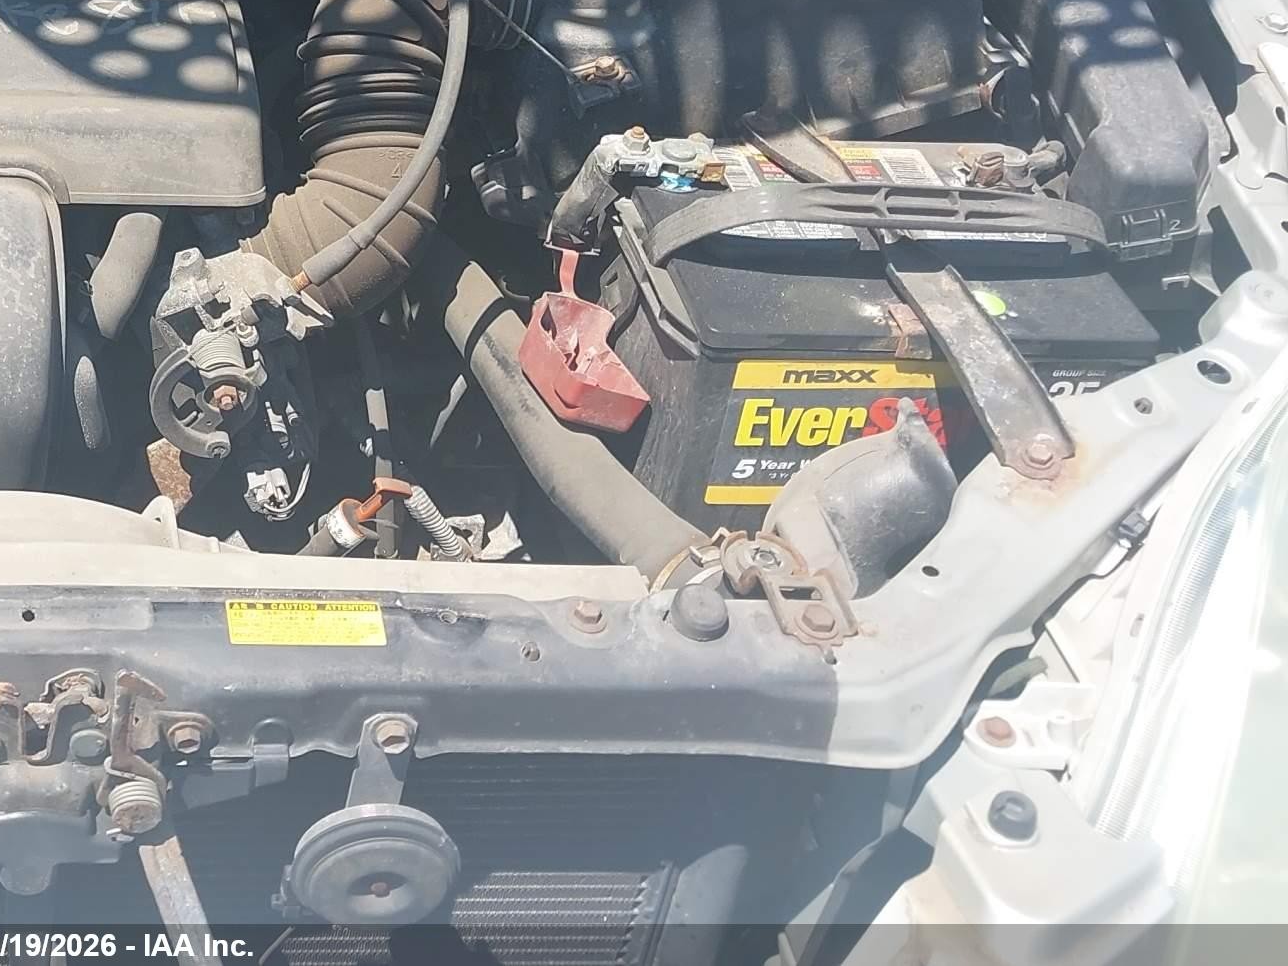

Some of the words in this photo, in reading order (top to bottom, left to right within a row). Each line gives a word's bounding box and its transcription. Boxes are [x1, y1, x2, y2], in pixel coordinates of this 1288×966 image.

[782, 369, 880, 384] maxx
[731, 458, 757, 479] 5
[760, 459, 796, 470] Year
[270, 603, 318, 611] CAUTION
[324, 604, 376, 612] ATTENTION
